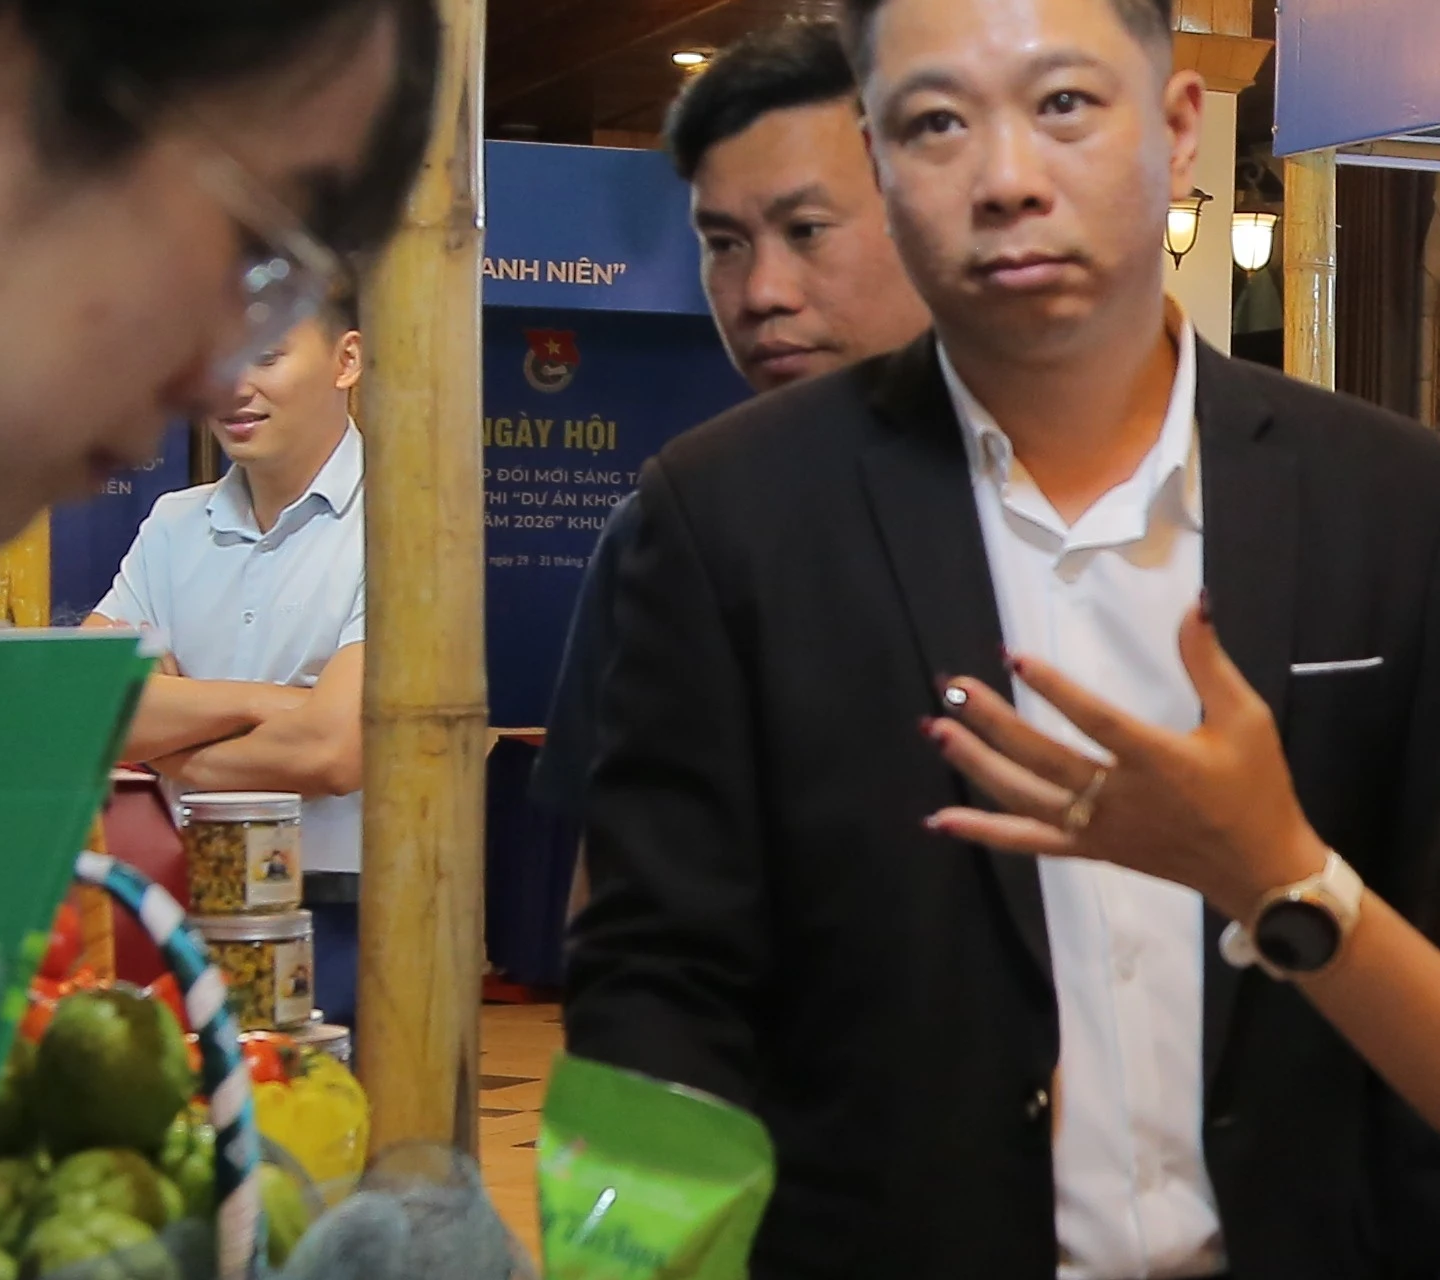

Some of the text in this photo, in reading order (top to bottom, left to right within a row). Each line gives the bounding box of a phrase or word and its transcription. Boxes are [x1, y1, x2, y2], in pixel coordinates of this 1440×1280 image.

[483, 257, 626, 285] ANH NIÊN”
[564, 414, 616, 456] HỘI
[574, 468, 621, 484] SÁNG
[552, 490, 577, 507] ÁN
[484, 511, 509, 528] ĂM
